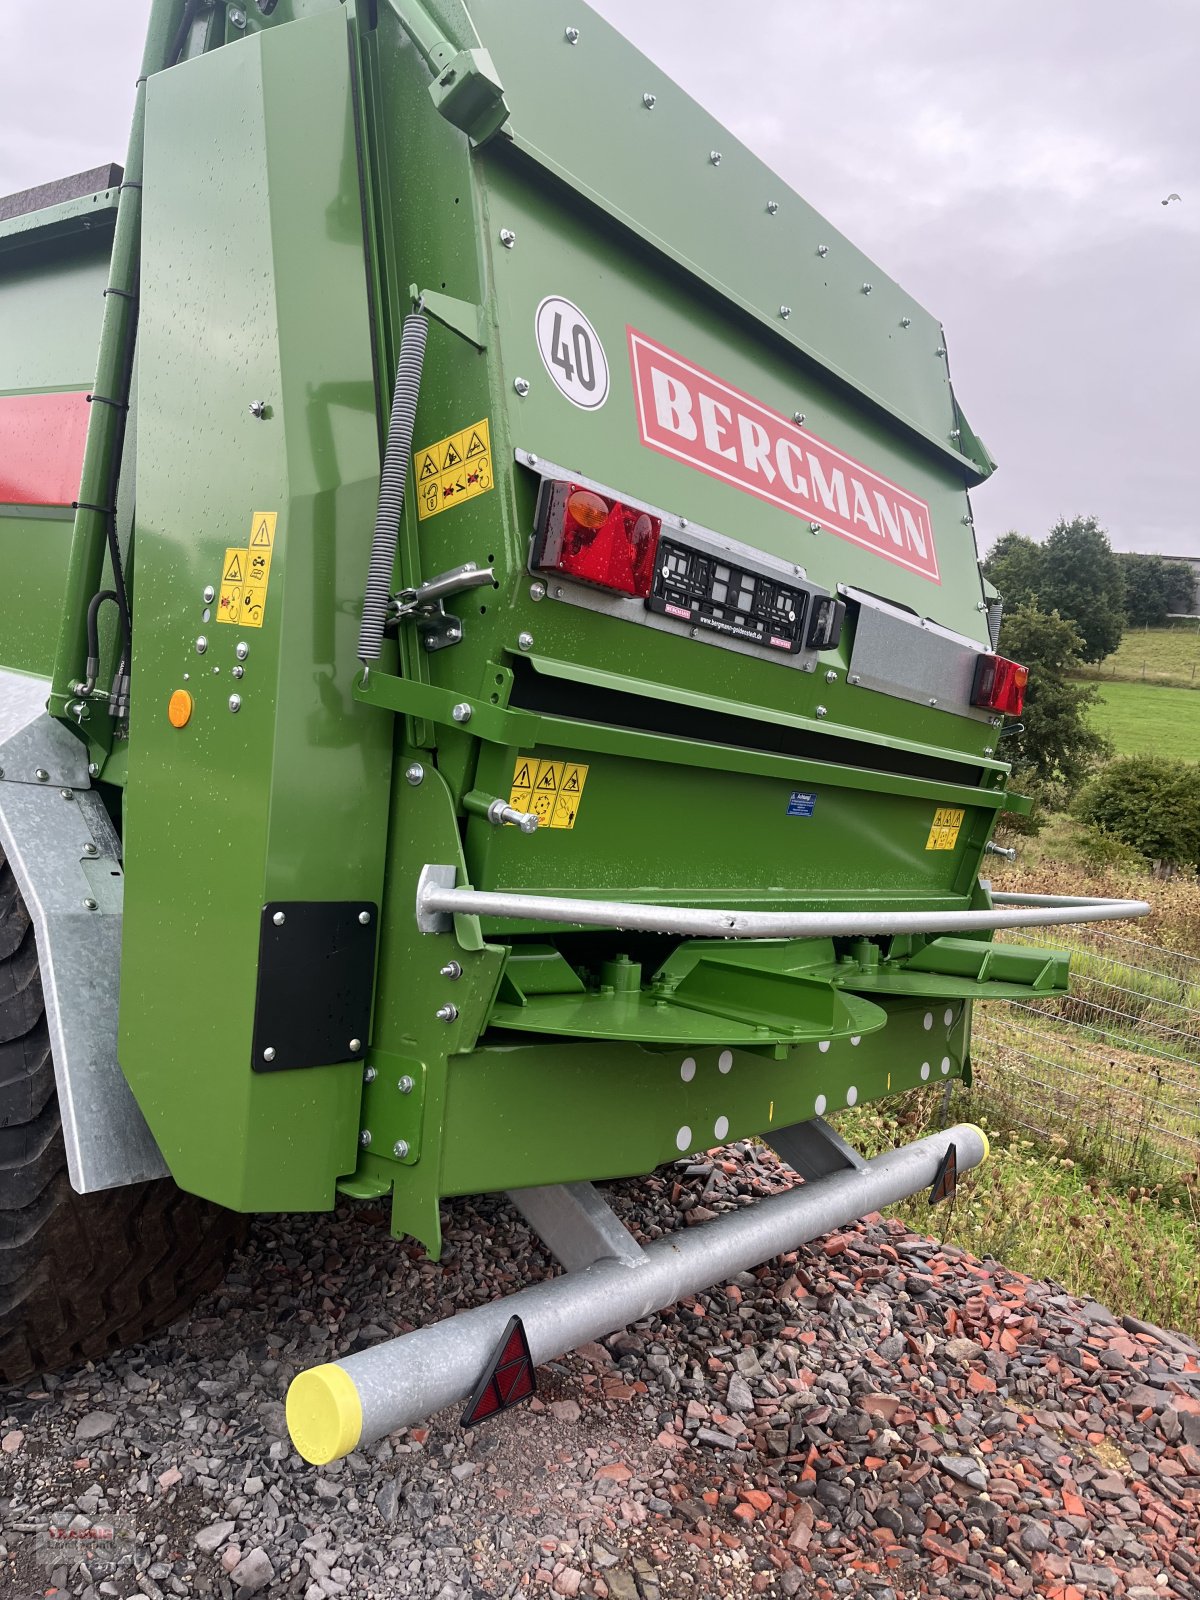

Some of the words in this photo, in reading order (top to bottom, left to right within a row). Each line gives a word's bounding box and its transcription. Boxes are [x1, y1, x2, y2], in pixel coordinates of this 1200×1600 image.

[551, 312, 595, 391] 40
[651, 366, 929, 560] BERGMANN
[700, 617, 762, 640] www.bergmann-goldenstedt.de
